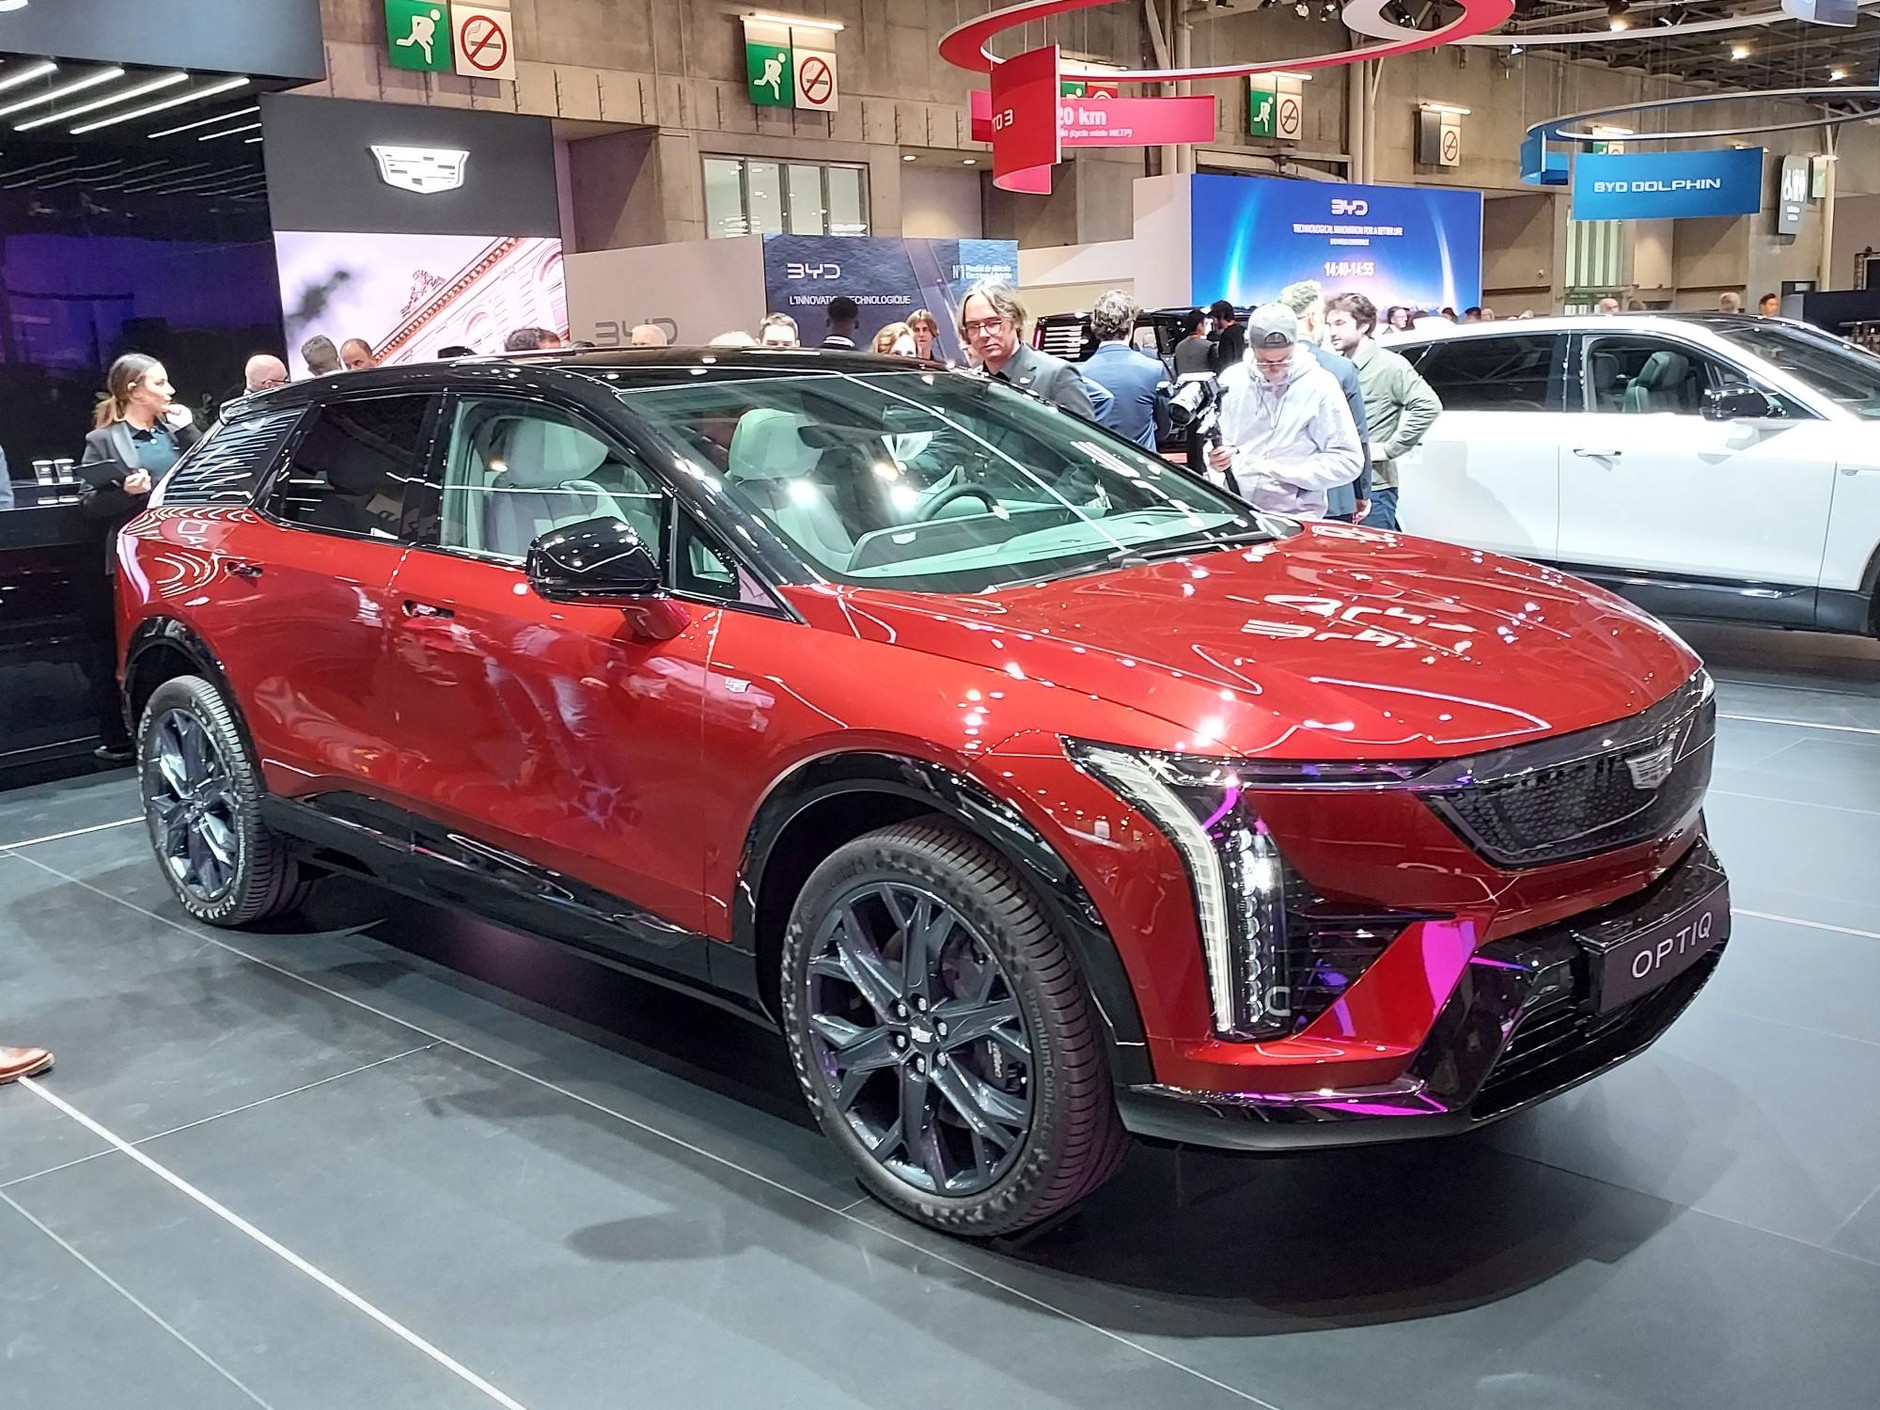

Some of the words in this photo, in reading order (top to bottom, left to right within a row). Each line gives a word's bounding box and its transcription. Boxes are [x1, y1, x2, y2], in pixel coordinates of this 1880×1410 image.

[1004, 108, 1014, 127] 3
[1078, 106, 1107, 126] km
[1593, 181, 1628, 193] BYD
[1631, 179, 1721, 192] DOLPHIN
[1331, 198, 1369, 216] BYD
[786, 262, 841, 280] BYD
[789, 295, 838, 305] L'INNOVATI
[847, 295, 911, 305] ECHNOLOGIQUE
[1631, 911, 1713, 979] OPTIQ
